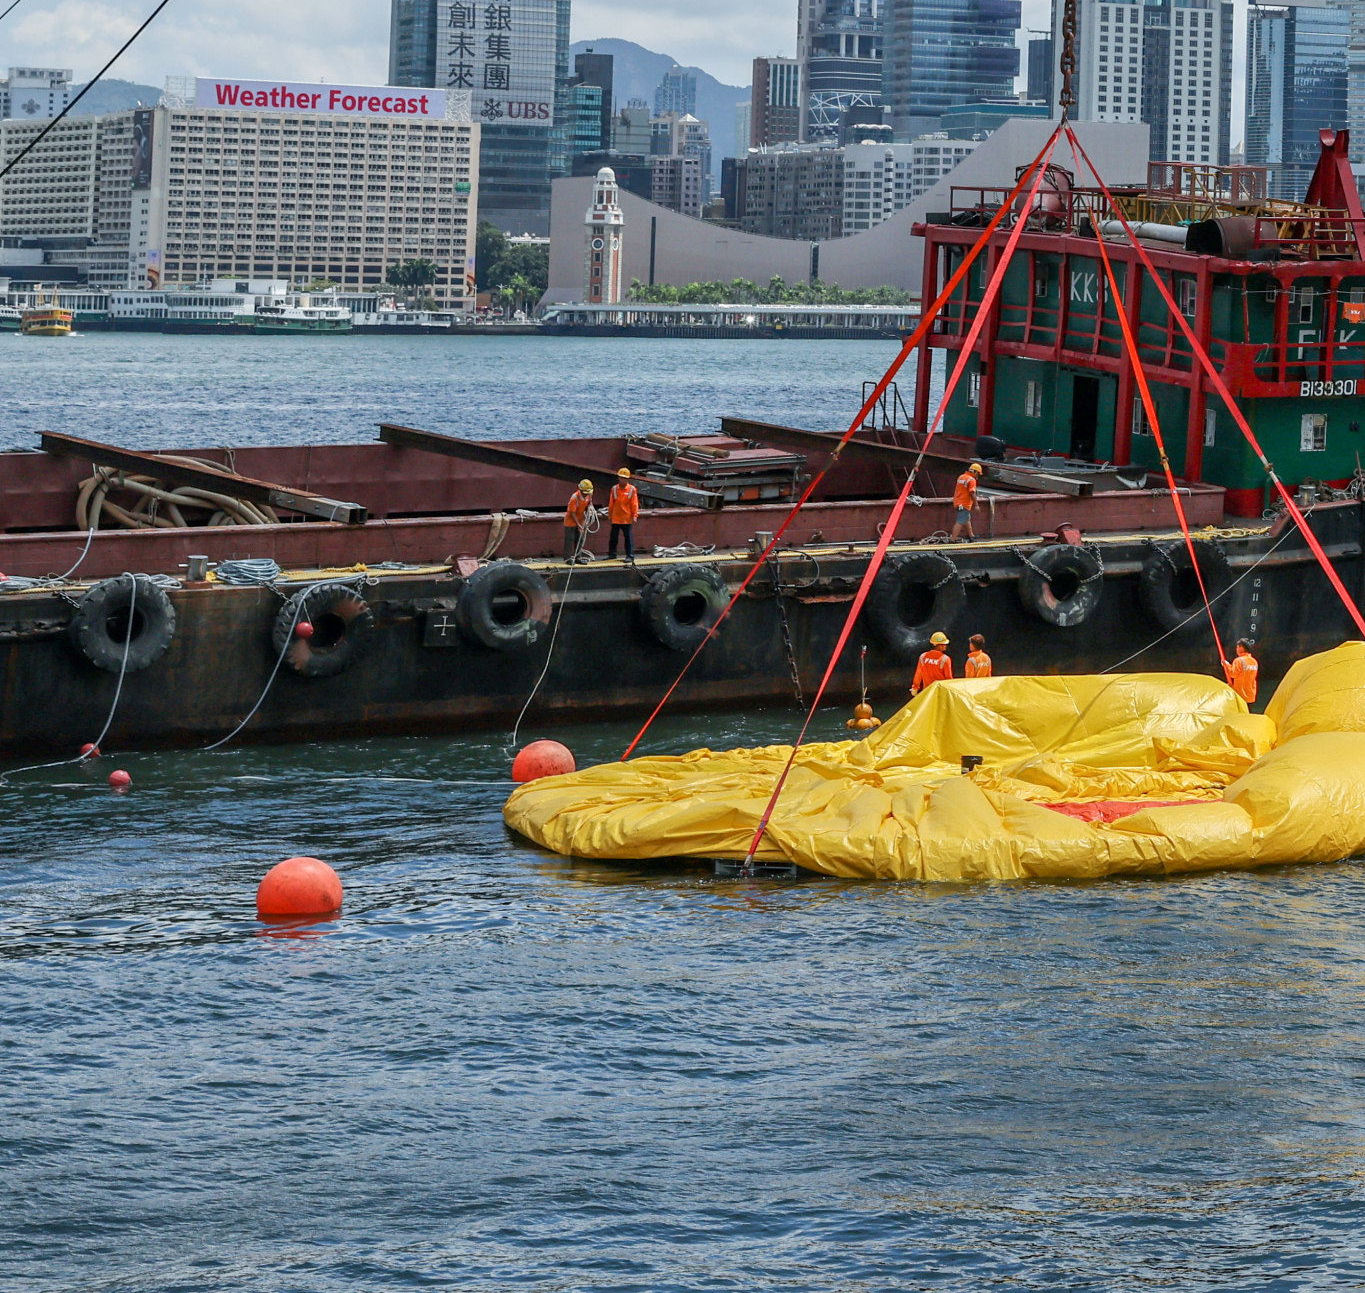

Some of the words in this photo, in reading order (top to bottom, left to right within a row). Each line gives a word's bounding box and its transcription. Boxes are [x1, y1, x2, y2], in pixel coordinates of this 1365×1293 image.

[215, 84, 321, 110] Weather
[329, 89, 429, 115] Forecast
[507, 101, 550, 120] UBS
[1253, 578, 1261, 587] 12
[1252, 592, 1259, 602] 11
[1250, 608, 1258, 617] 10
[1250, 623, 1256, 633] 9
[924, 657, 939, 665] FKK
